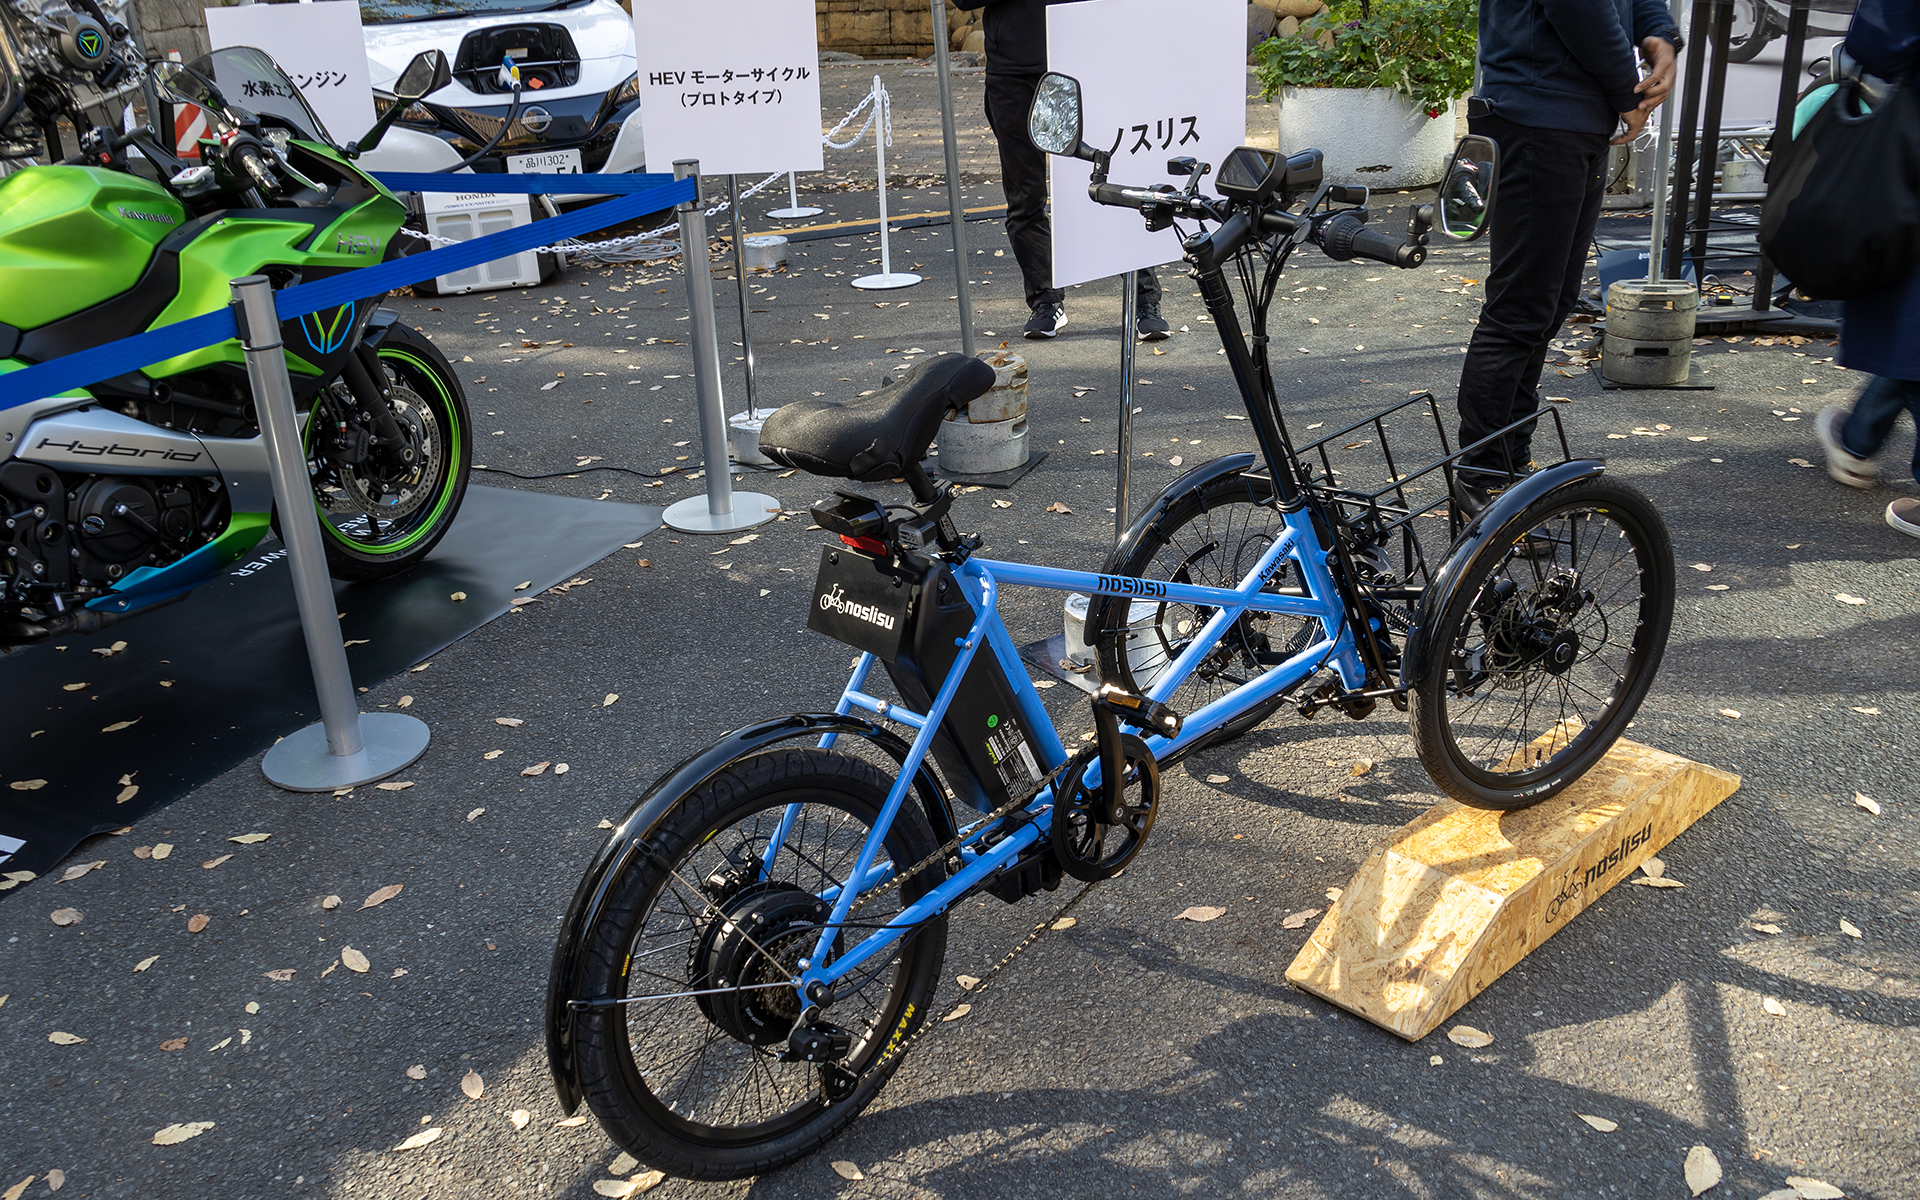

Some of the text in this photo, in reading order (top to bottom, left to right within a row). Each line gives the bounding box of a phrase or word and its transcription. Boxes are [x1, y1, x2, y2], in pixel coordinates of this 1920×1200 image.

[650, 66, 811, 85] HEV モーターサイクル
[1108, 115, 1201, 156] ノスリス
[117, 206, 176, 226] Kawasaki
[336, 232, 381, 257] HEV
[36, 438, 202, 463] Hybrid
[1257, 537, 1296, 583] Kawasaki
[1096, 575, 1168, 598] noslisu
[844, 600, 896, 631] noslisu
[1584, 822, 1653, 889] noslisu
